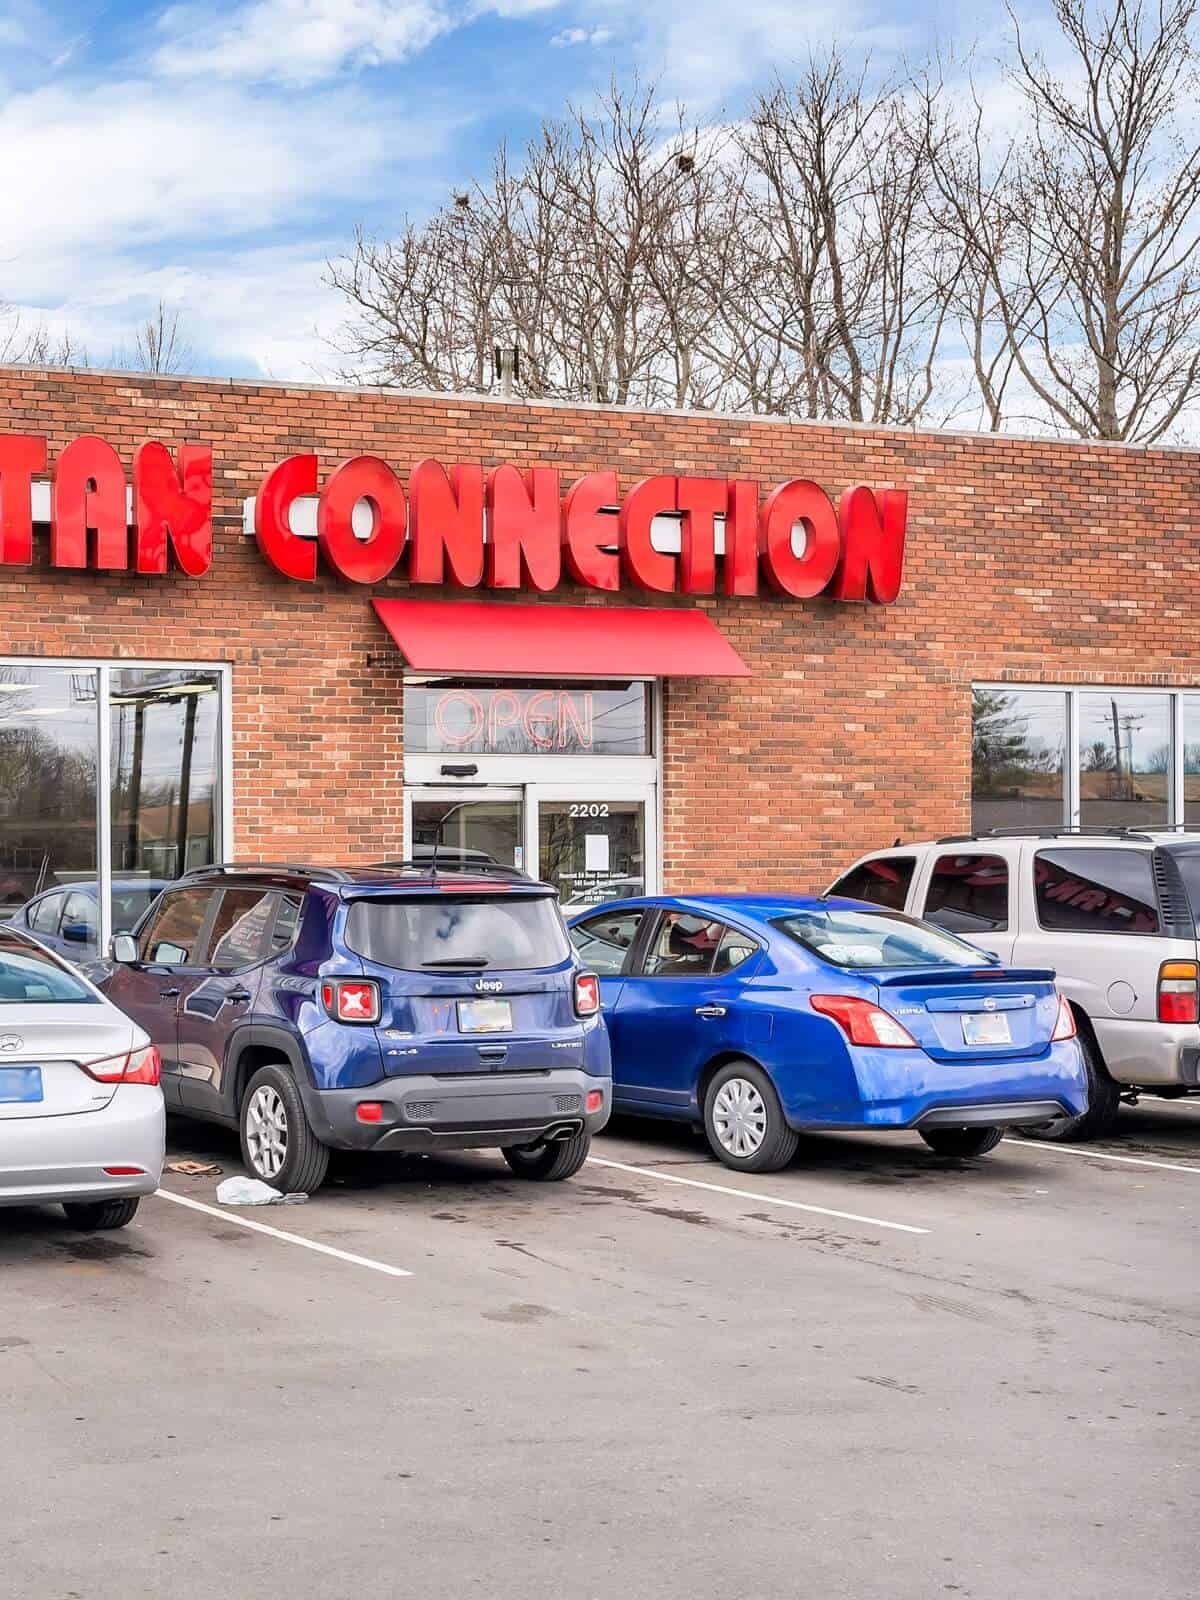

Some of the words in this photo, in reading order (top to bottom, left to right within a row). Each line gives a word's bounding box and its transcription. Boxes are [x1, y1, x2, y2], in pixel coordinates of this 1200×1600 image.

[255, 453, 908, 605] CONNECTION
[434, 690, 593, 748] OPEN
[569, 803, 609, 817] 2202
[475, 979, 503, 992] Jeep
